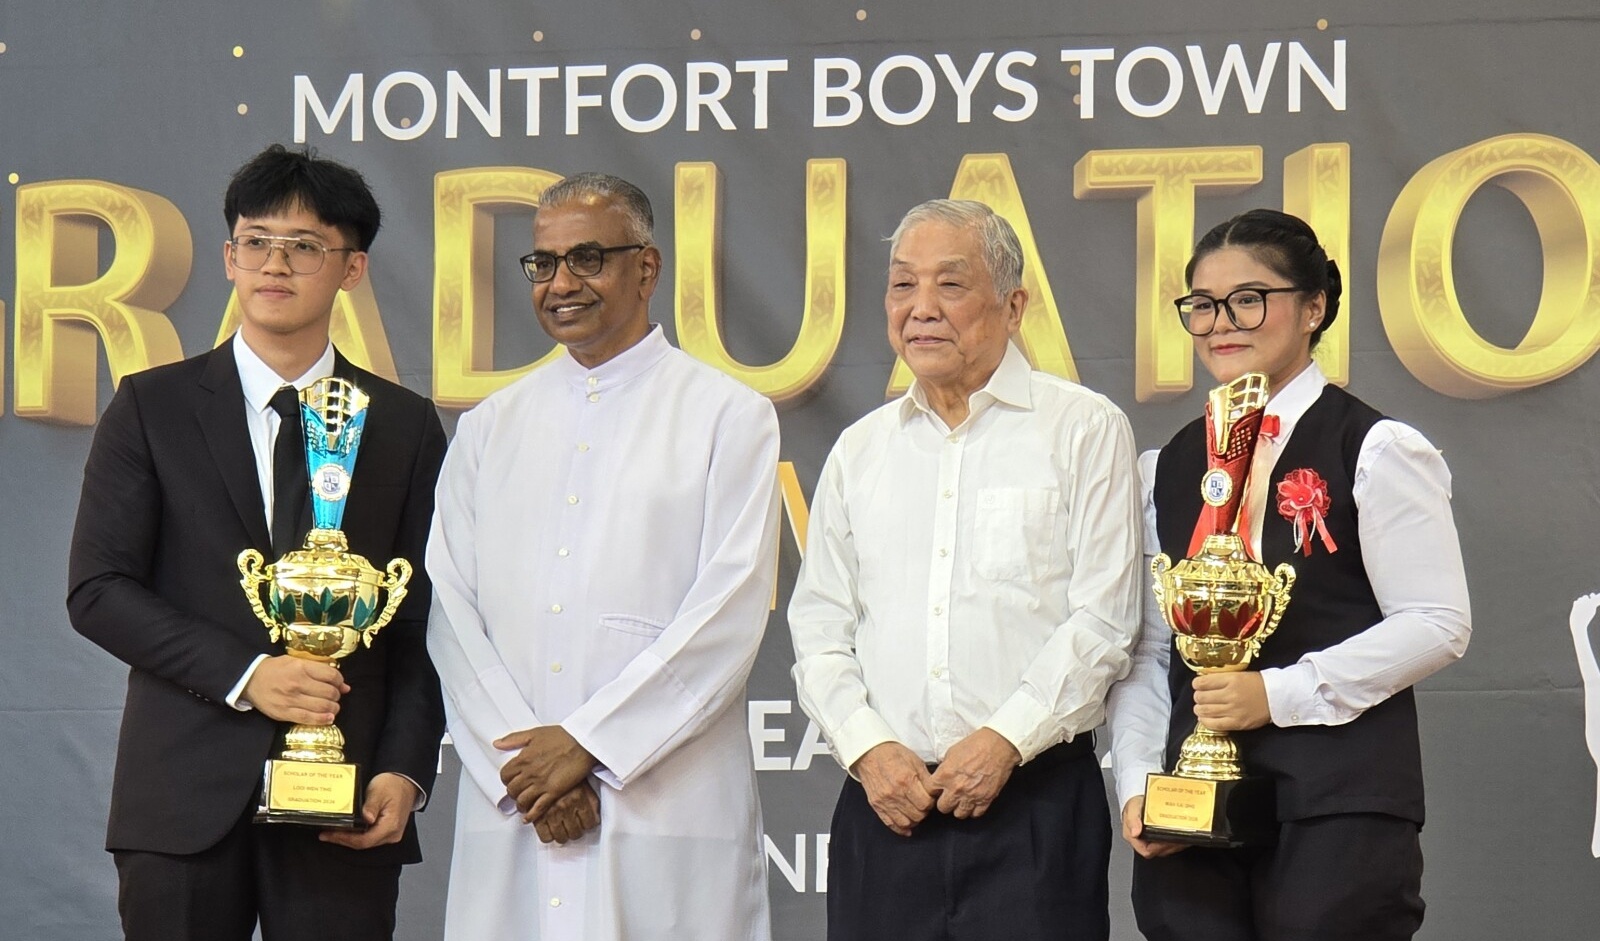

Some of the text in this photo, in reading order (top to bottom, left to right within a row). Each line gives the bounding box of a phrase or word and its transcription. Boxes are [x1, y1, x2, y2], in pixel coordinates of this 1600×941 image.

[293, 40, 1347, 143] MONTFORT BOYS TOWN
